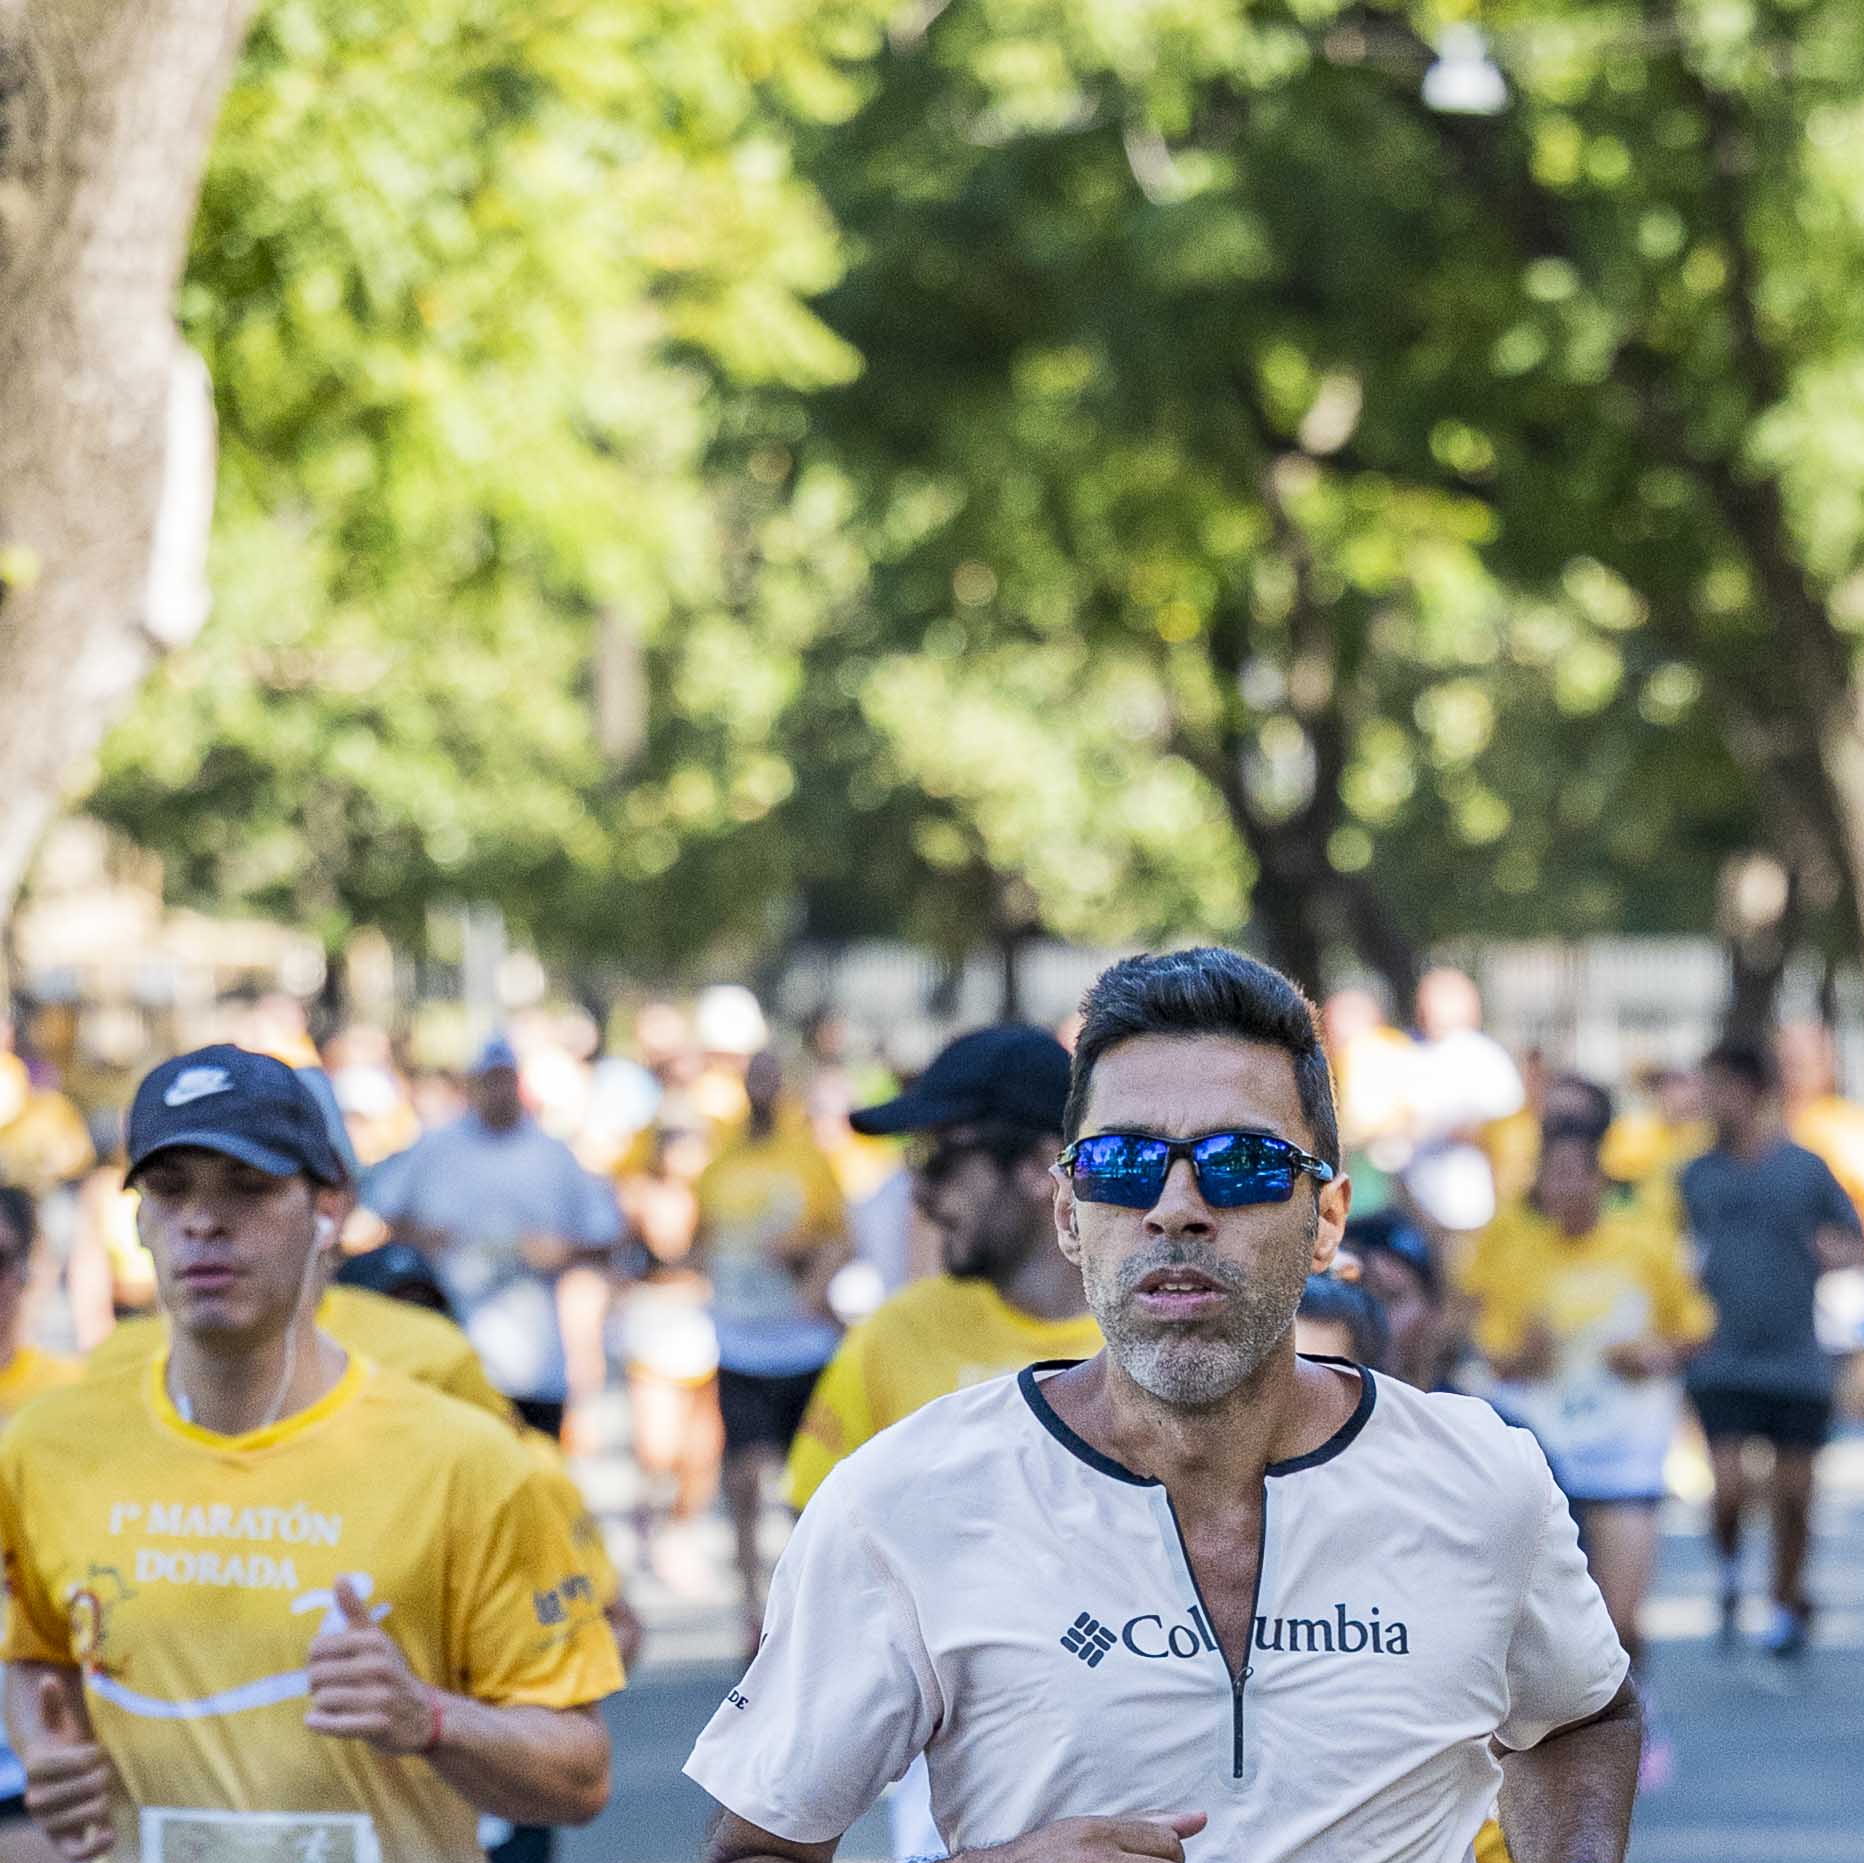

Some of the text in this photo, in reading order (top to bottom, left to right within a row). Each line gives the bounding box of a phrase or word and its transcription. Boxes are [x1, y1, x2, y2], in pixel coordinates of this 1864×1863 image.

[147, 1500, 341, 1547] MARATÓN
[135, 1547, 298, 1588] DORADA
[1121, 1603, 1410, 1659] Columbia
